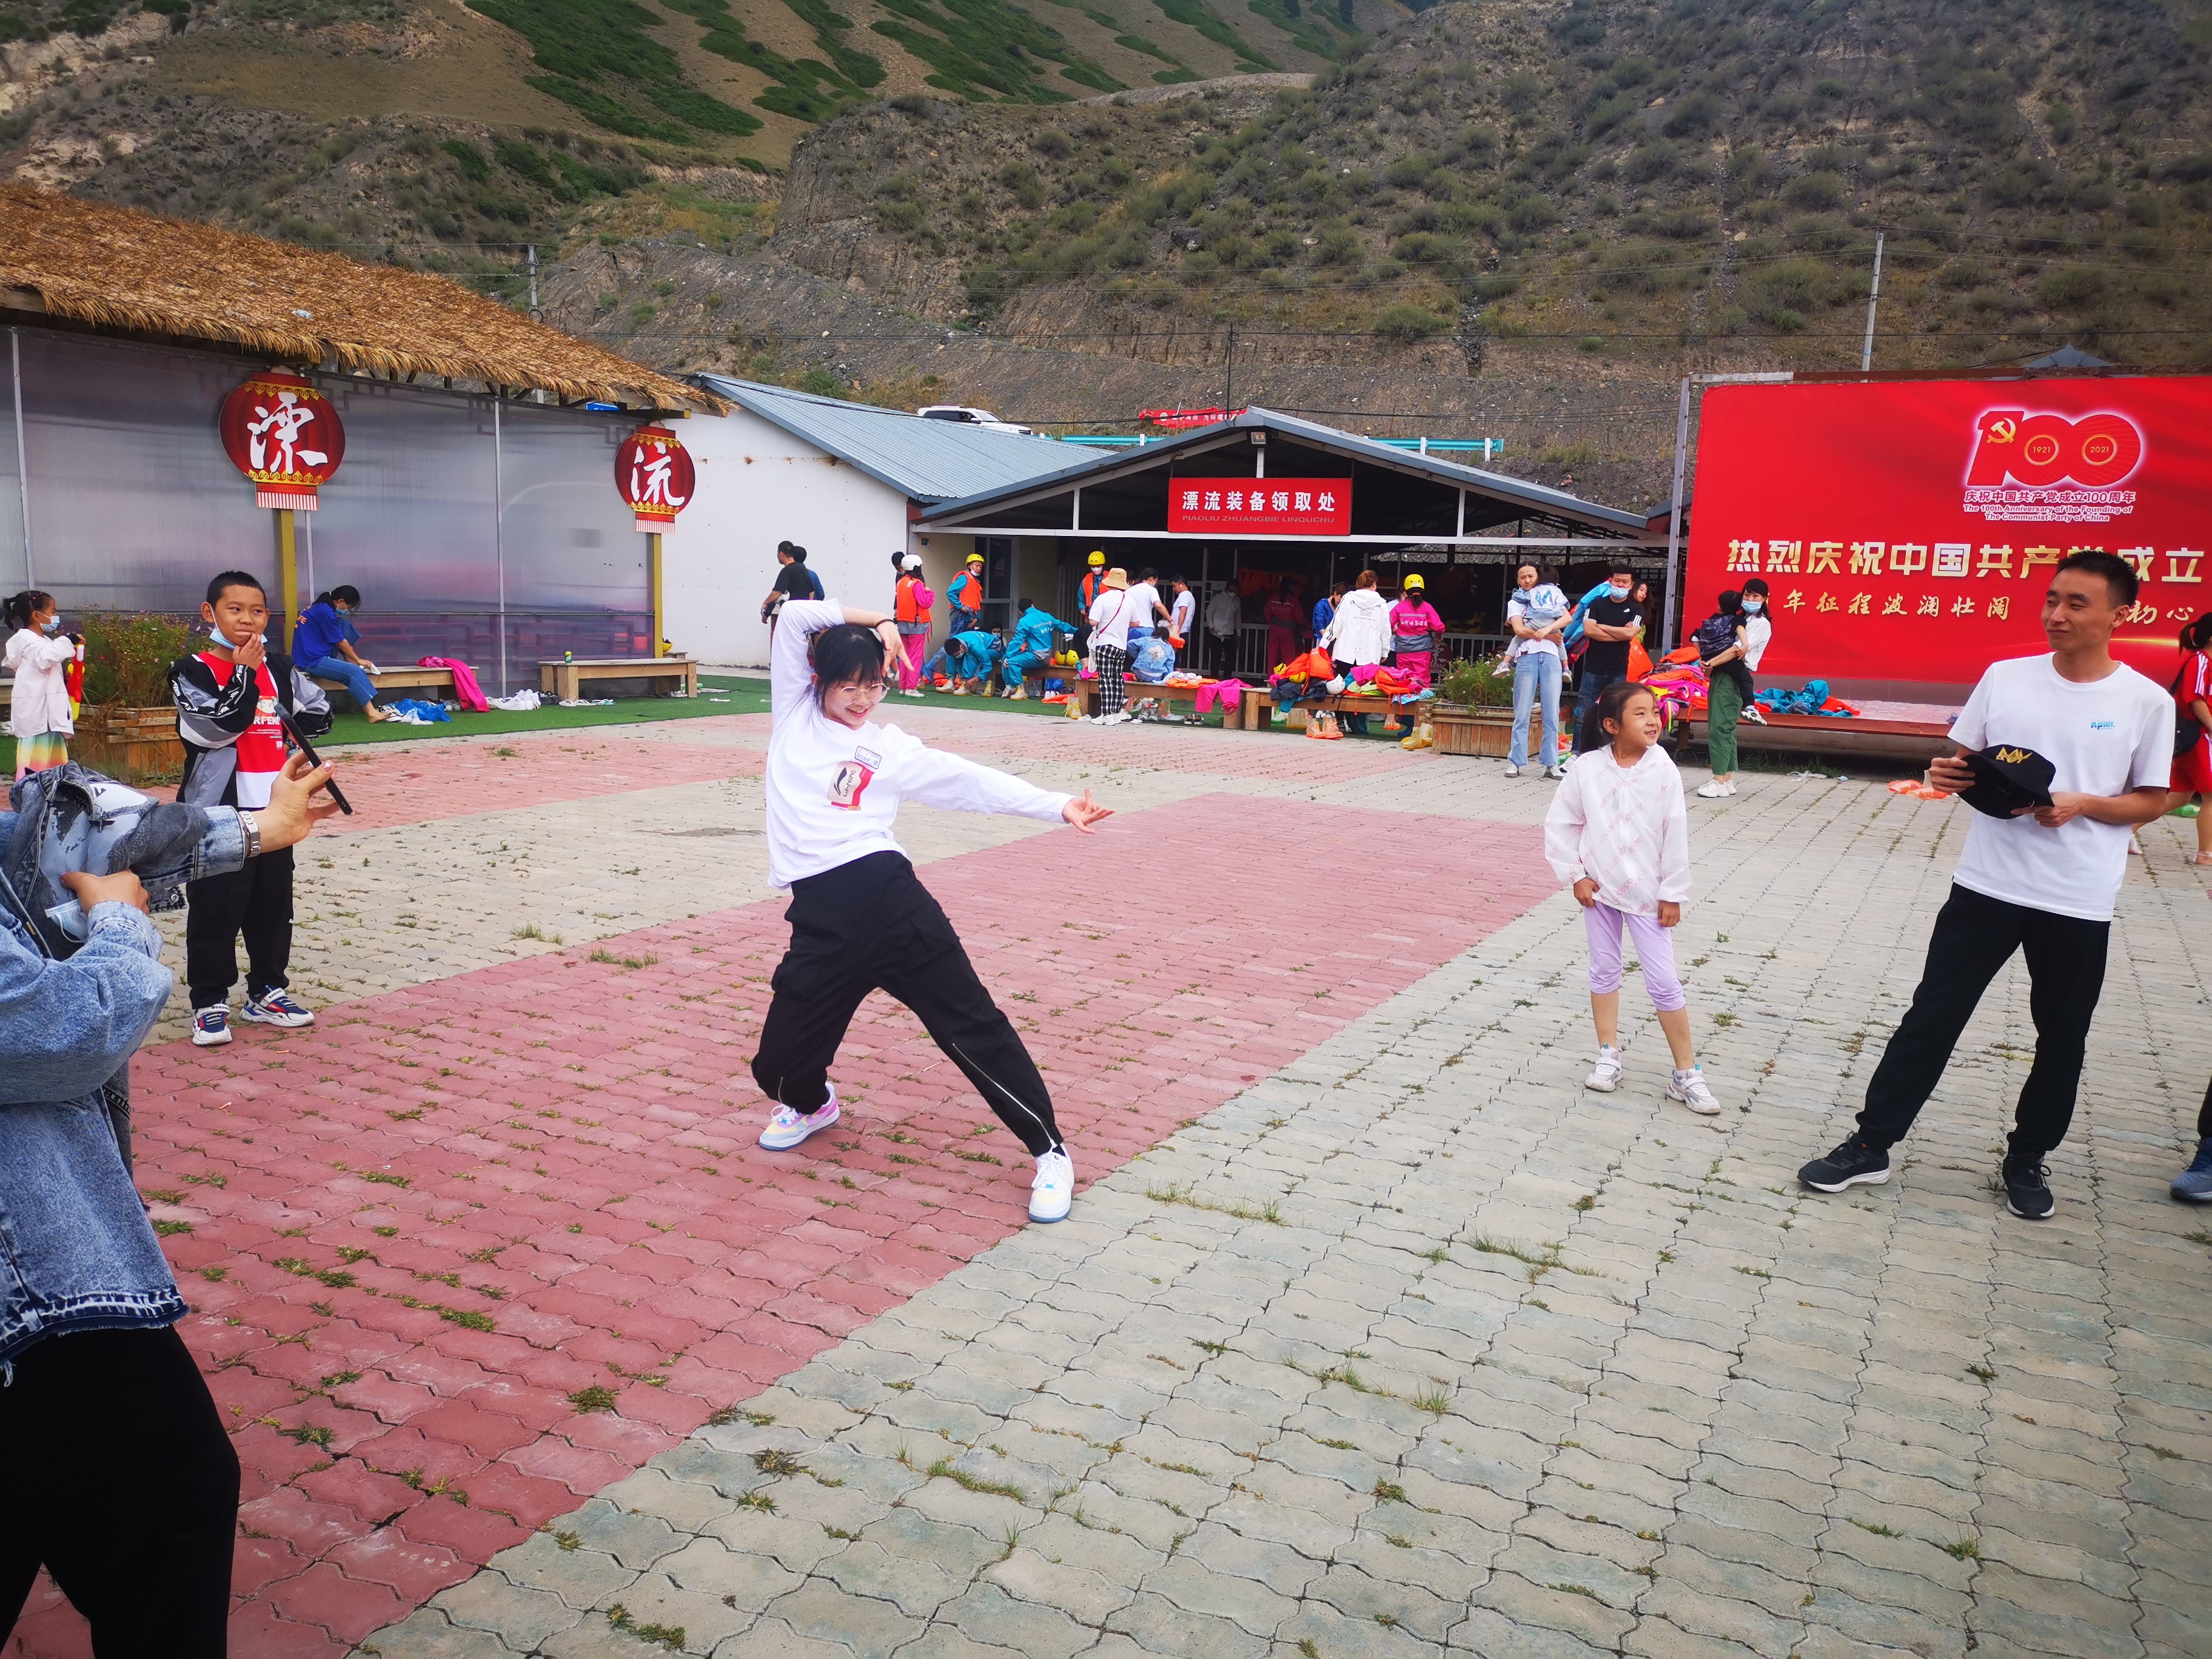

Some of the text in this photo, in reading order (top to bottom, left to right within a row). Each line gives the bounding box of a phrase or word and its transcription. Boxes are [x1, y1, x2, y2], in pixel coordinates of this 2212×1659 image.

[629, 441, 686, 507] 流
[1182, 491, 1335, 512] 漂流装备领取处
[1964, 491, 2135, 503] 庆祝中国共产党成立100周年
[1766, 589, 2010, 621] 年征程波澜壮阔
